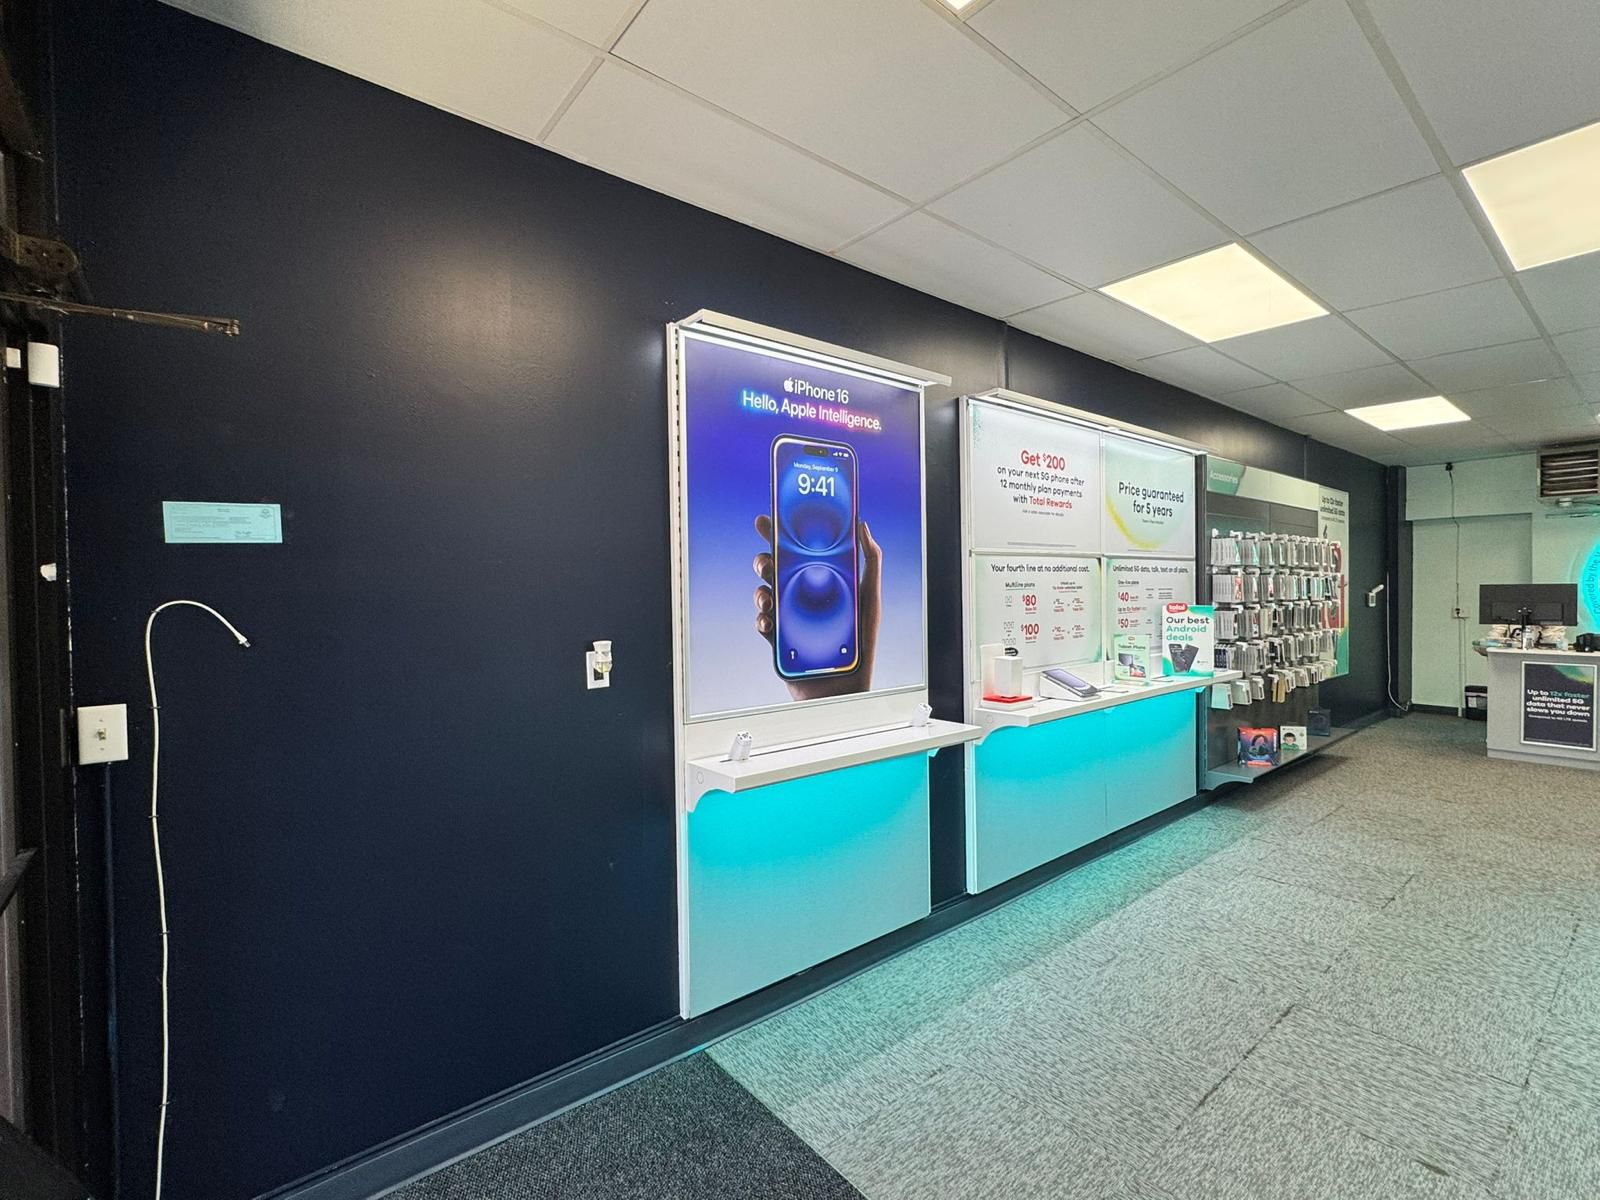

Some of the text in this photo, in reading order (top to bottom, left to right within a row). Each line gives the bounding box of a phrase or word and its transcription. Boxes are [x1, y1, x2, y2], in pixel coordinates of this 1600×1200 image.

[794, 379, 849, 404] iPhone 16
[742, 390, 882, 430] Hello, Apple Intelligence.
[1021, 450, 1065, 471] Get $200
[798, 473, 834, 496] 9:41
[997, 466, 1084, 486] on your next 5G phone after
[1000, 479, 1082, 498] 12 monthly plan payments
[1119, 482, 1184, 503] Price guaranteed
[1013, 494, 1072, 509] with Total Rewards
[1133, 500, 1173, 517] for 5 years
[991, 564, 1005, 572] Your
[1007, 563, 1025, 572] fourth
[1026, 564, 1036, 572] line
[1022, 594, 1036, 606] $80
[1021, 623, 1039, 635] $100
[1188, 616, 1210, 624] best
